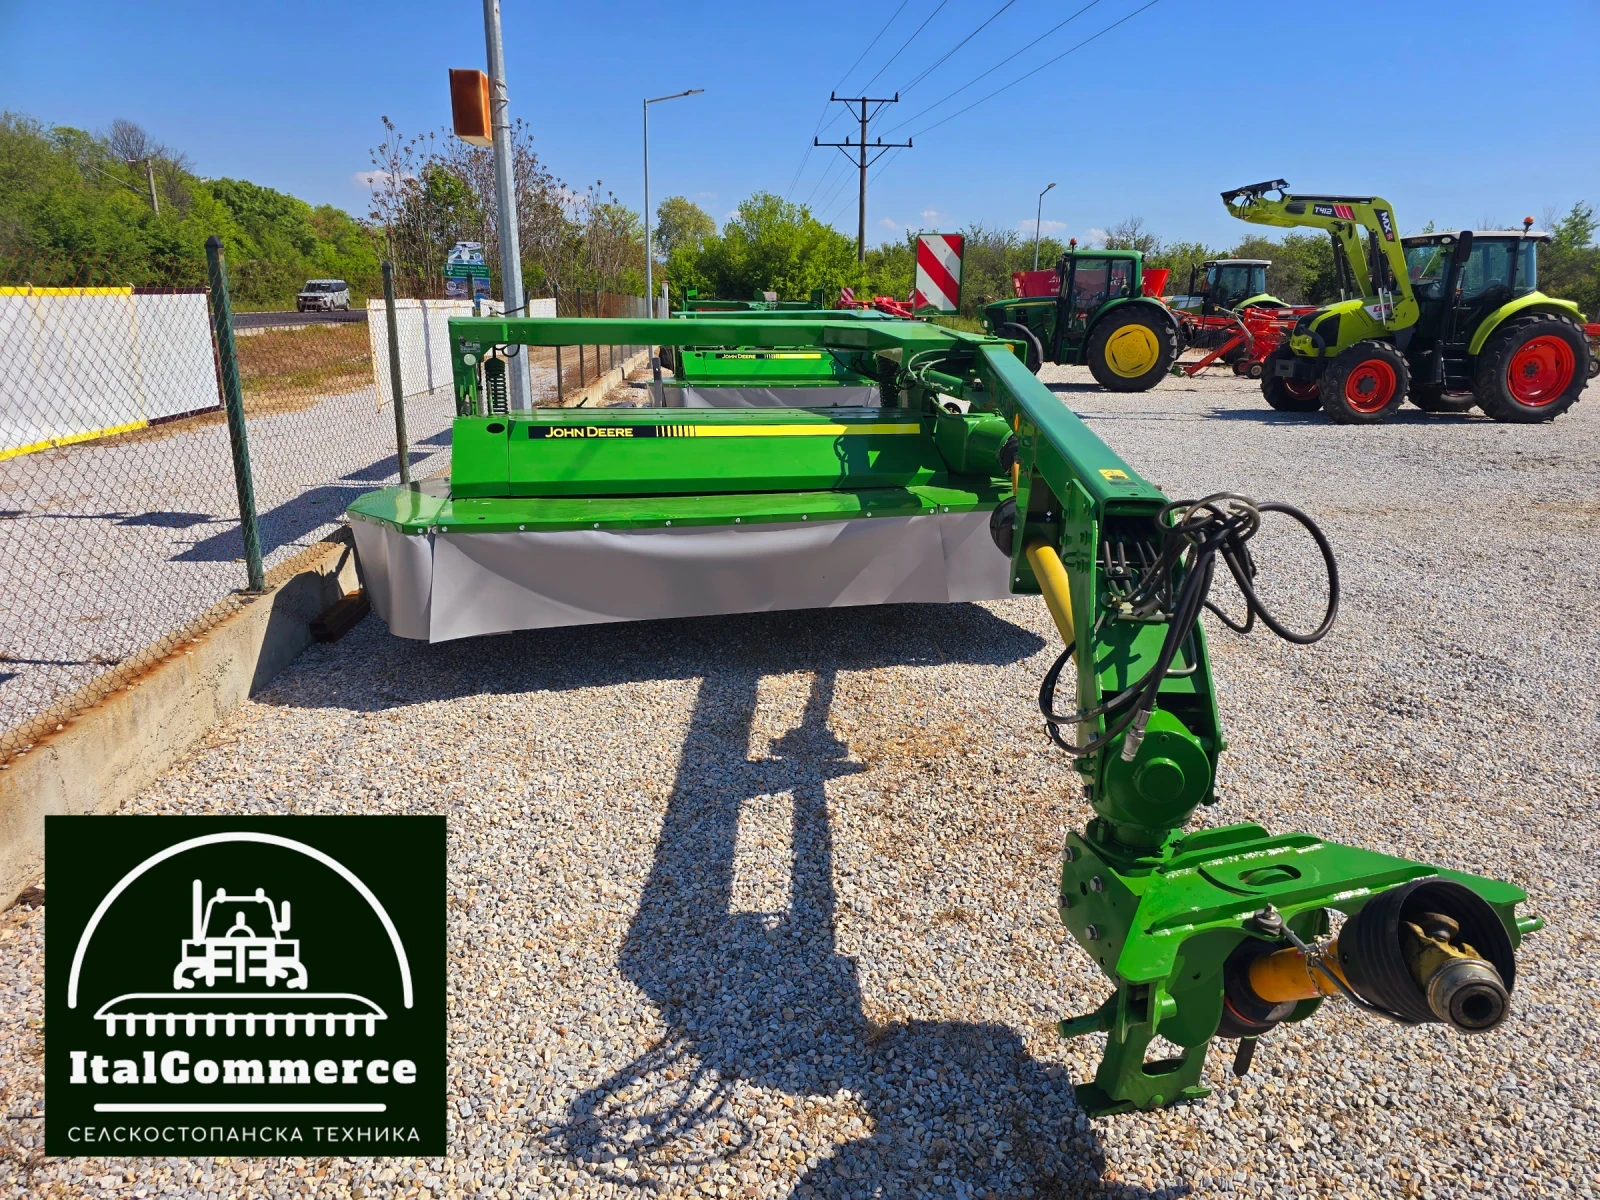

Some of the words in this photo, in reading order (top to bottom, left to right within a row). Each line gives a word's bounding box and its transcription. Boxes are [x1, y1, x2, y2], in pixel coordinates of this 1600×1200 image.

[1315, 206, 1333, 215] T412
[1381, 211, 1392, 233] MX
[545, 426, 585, 438] JOHN
[586, 426, 634, 438] DEERE
